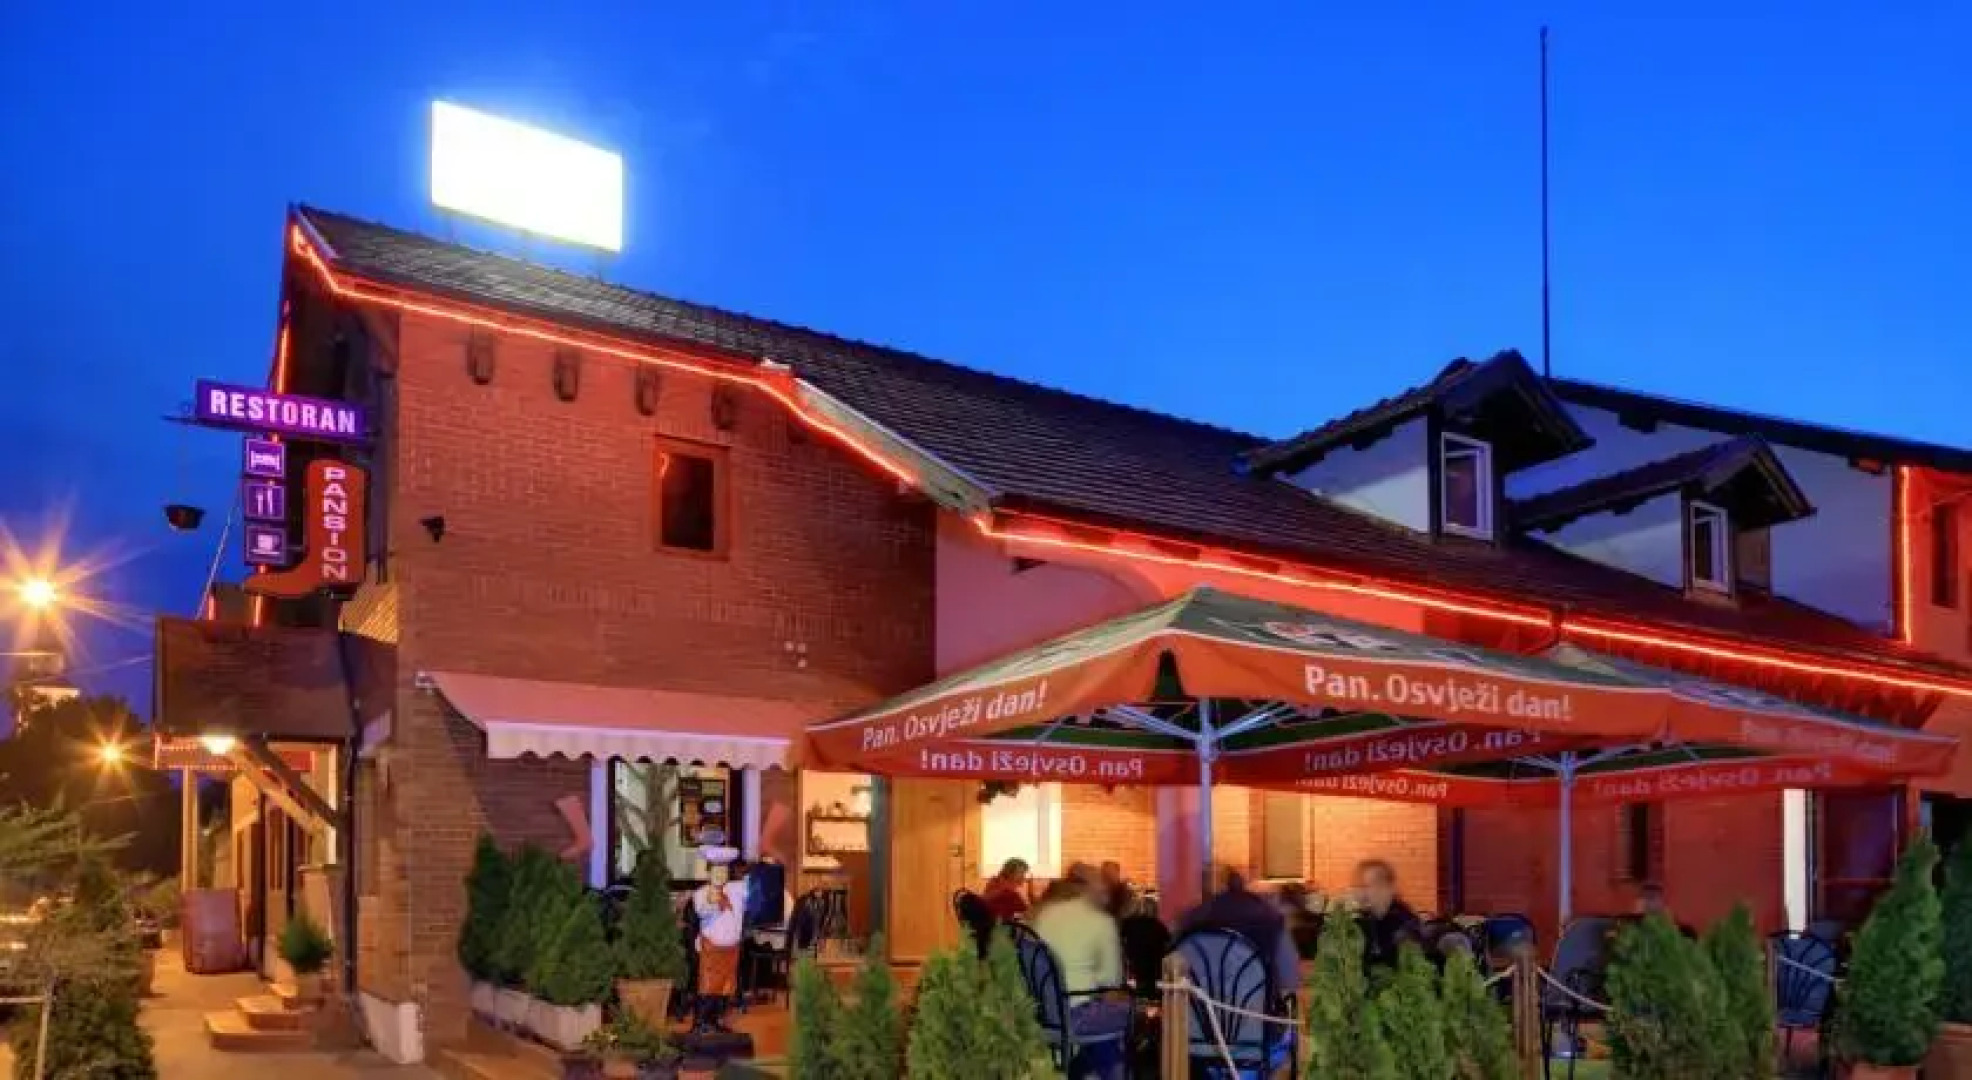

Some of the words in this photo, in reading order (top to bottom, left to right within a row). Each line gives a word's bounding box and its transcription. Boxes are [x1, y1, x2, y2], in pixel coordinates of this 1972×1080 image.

[210, 388, 356, 433] RESTORAN
[322, 466, 348, 581] PANSION
[863, 723, 900, 752] Pan.
[903, 696, 984, 740] Osvježi
[985, 681, 1048, 720] dan!
[1304, 664, 1379, 700] Pan.
[1386, 673, 1499, 713] Osvježi
[1507, 689, 1573, 721] dan!
